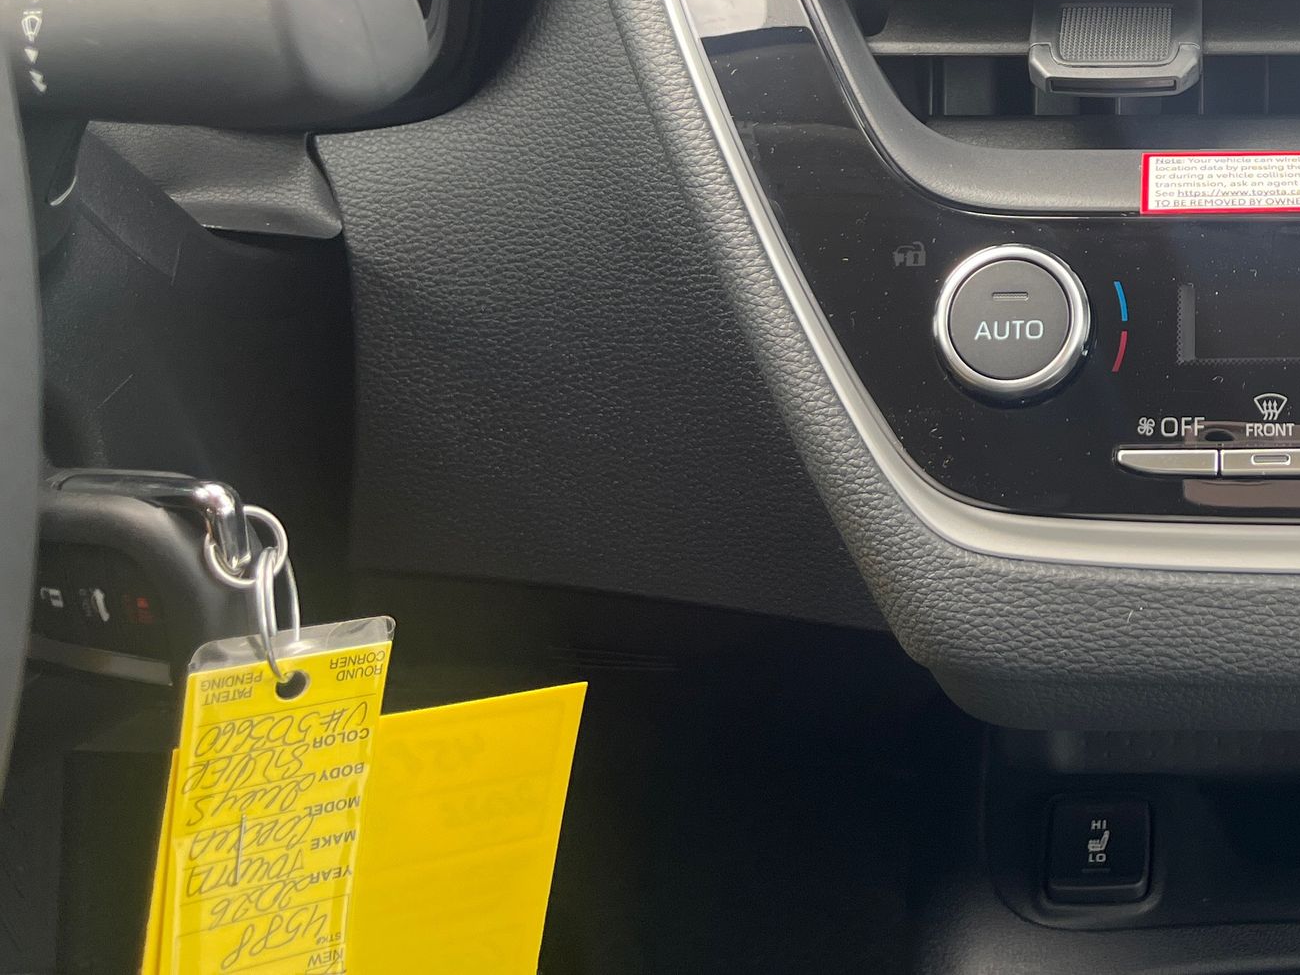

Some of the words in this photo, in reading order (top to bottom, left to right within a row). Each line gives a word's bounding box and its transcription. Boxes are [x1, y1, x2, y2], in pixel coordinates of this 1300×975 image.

[1188, 157, 1213, 165] Your
[1226, 164, 1239, 173] by
[1241, 164, 1285, 173] pressing
[1168, 172, 1204, 181] during
[1267, 180, 1298, 189] agent
[1155, 189, 1175, 197] See
[1155, 199, 1171, 207] TO
[1173, 199, 1187, 207] BE
[1189, 198, 1246, 207] REMOVED
[1249, 198, 1263, 206] BY
[974, 319, 1045, 341] AUTO
[1160, 417, 1205, 437] OFF
[1246, 423, 1294, 437] FRONT
[330, 650, 386, 670] CORNER
[201, 671, 263, 691] PENDING
[336, 664, 383, 681] ROUND
[203, 686, 254, 706] PATENT
[313, 727, 371, 748] COLOR
[318, 761, 365, 783] BODY
[304, 795, 360, 818] MODEL
[1091, 819, 1107, 830] HI
[310, 829, 356, 851] MAKE
[1088, 853, 1107, 863] LO
[309, 864, 353, 885] YEAR
[307, 949, 343, 968] NEW
